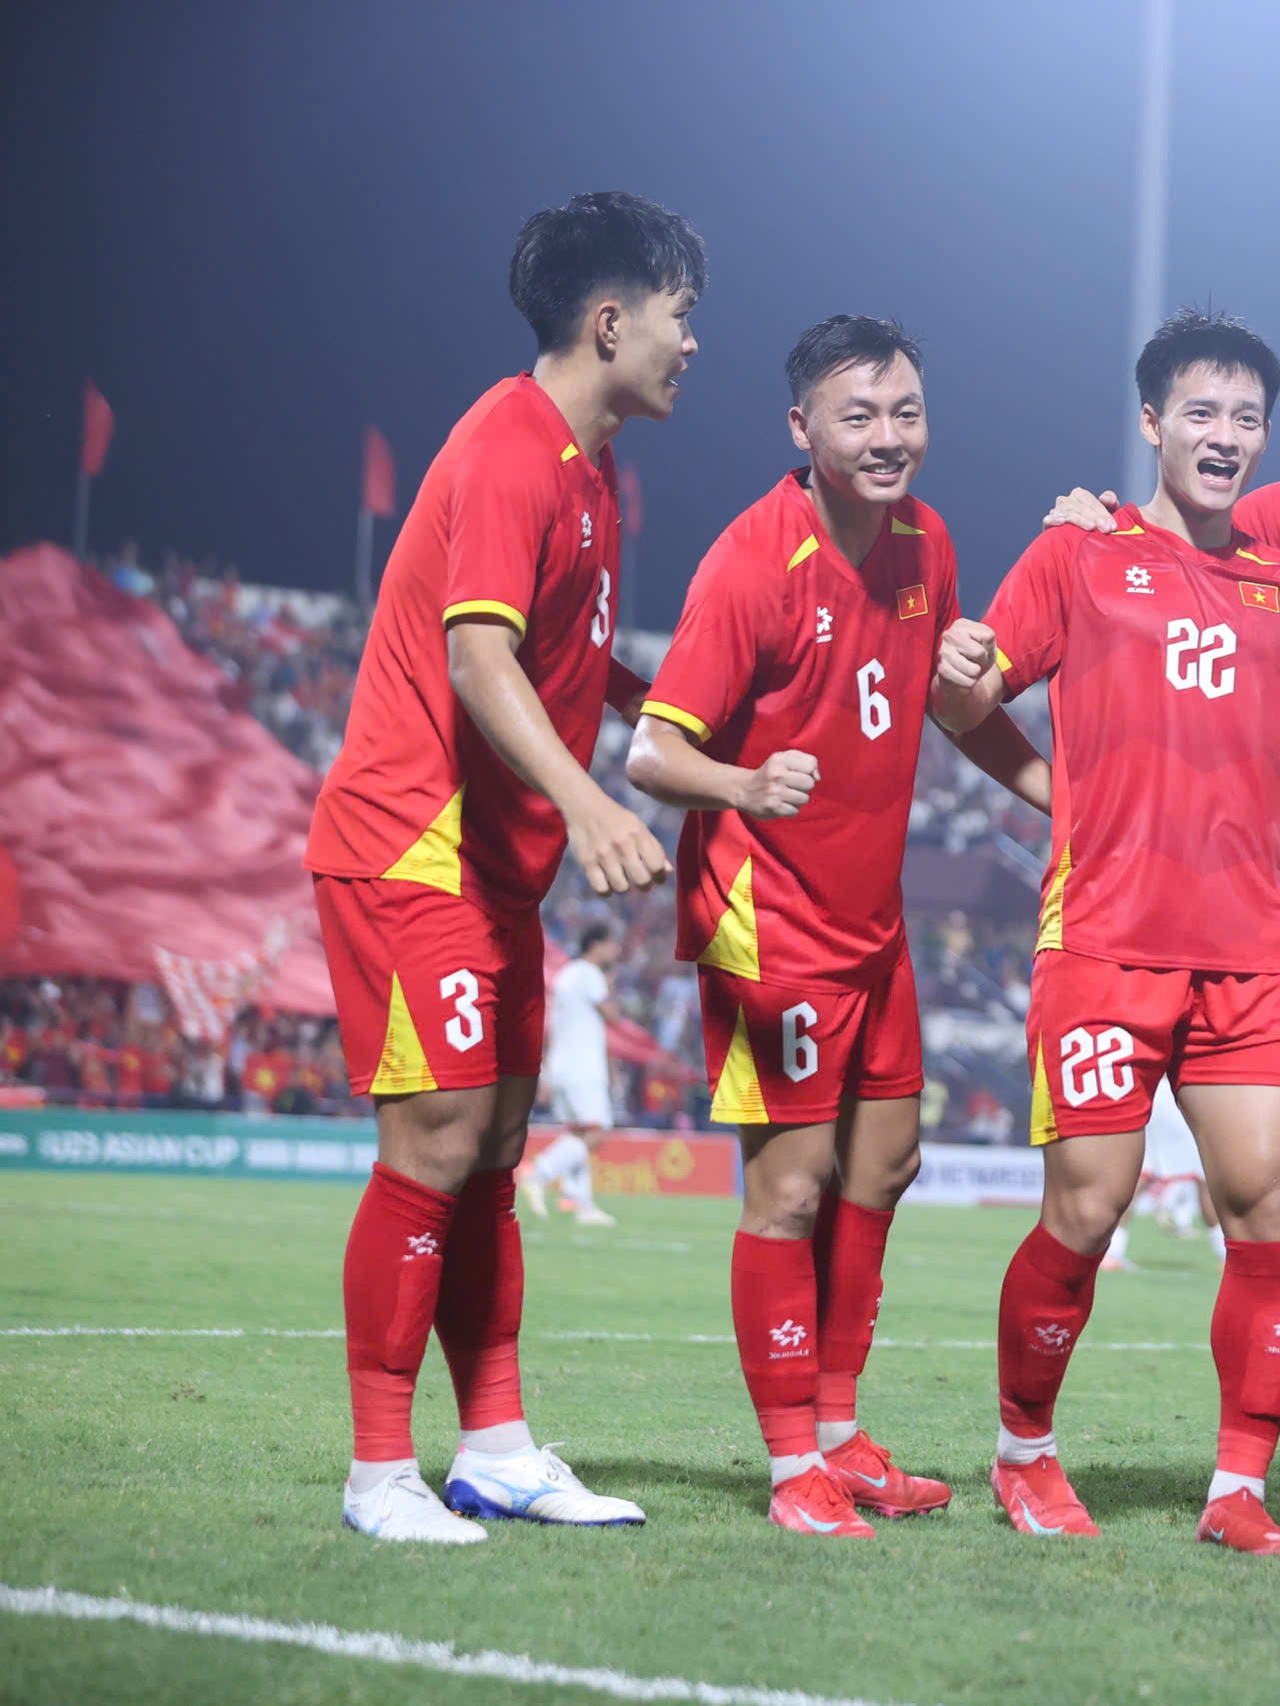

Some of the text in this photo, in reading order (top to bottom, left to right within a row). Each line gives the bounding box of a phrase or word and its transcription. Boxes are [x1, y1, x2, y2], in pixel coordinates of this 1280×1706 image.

[591, 566, 611, 649] 3
[856, 658, 892, 741] 6
[1165, 617, 1238, 700] 22
[439, 968, 484, 1053] 3
[782, 1001, 818, 1083] 6
[1060, 1026, 1135, 1108] 22
[103, 1132, 182, 1165] ASIAN
[184, 1135, 240, 1167] CUP
